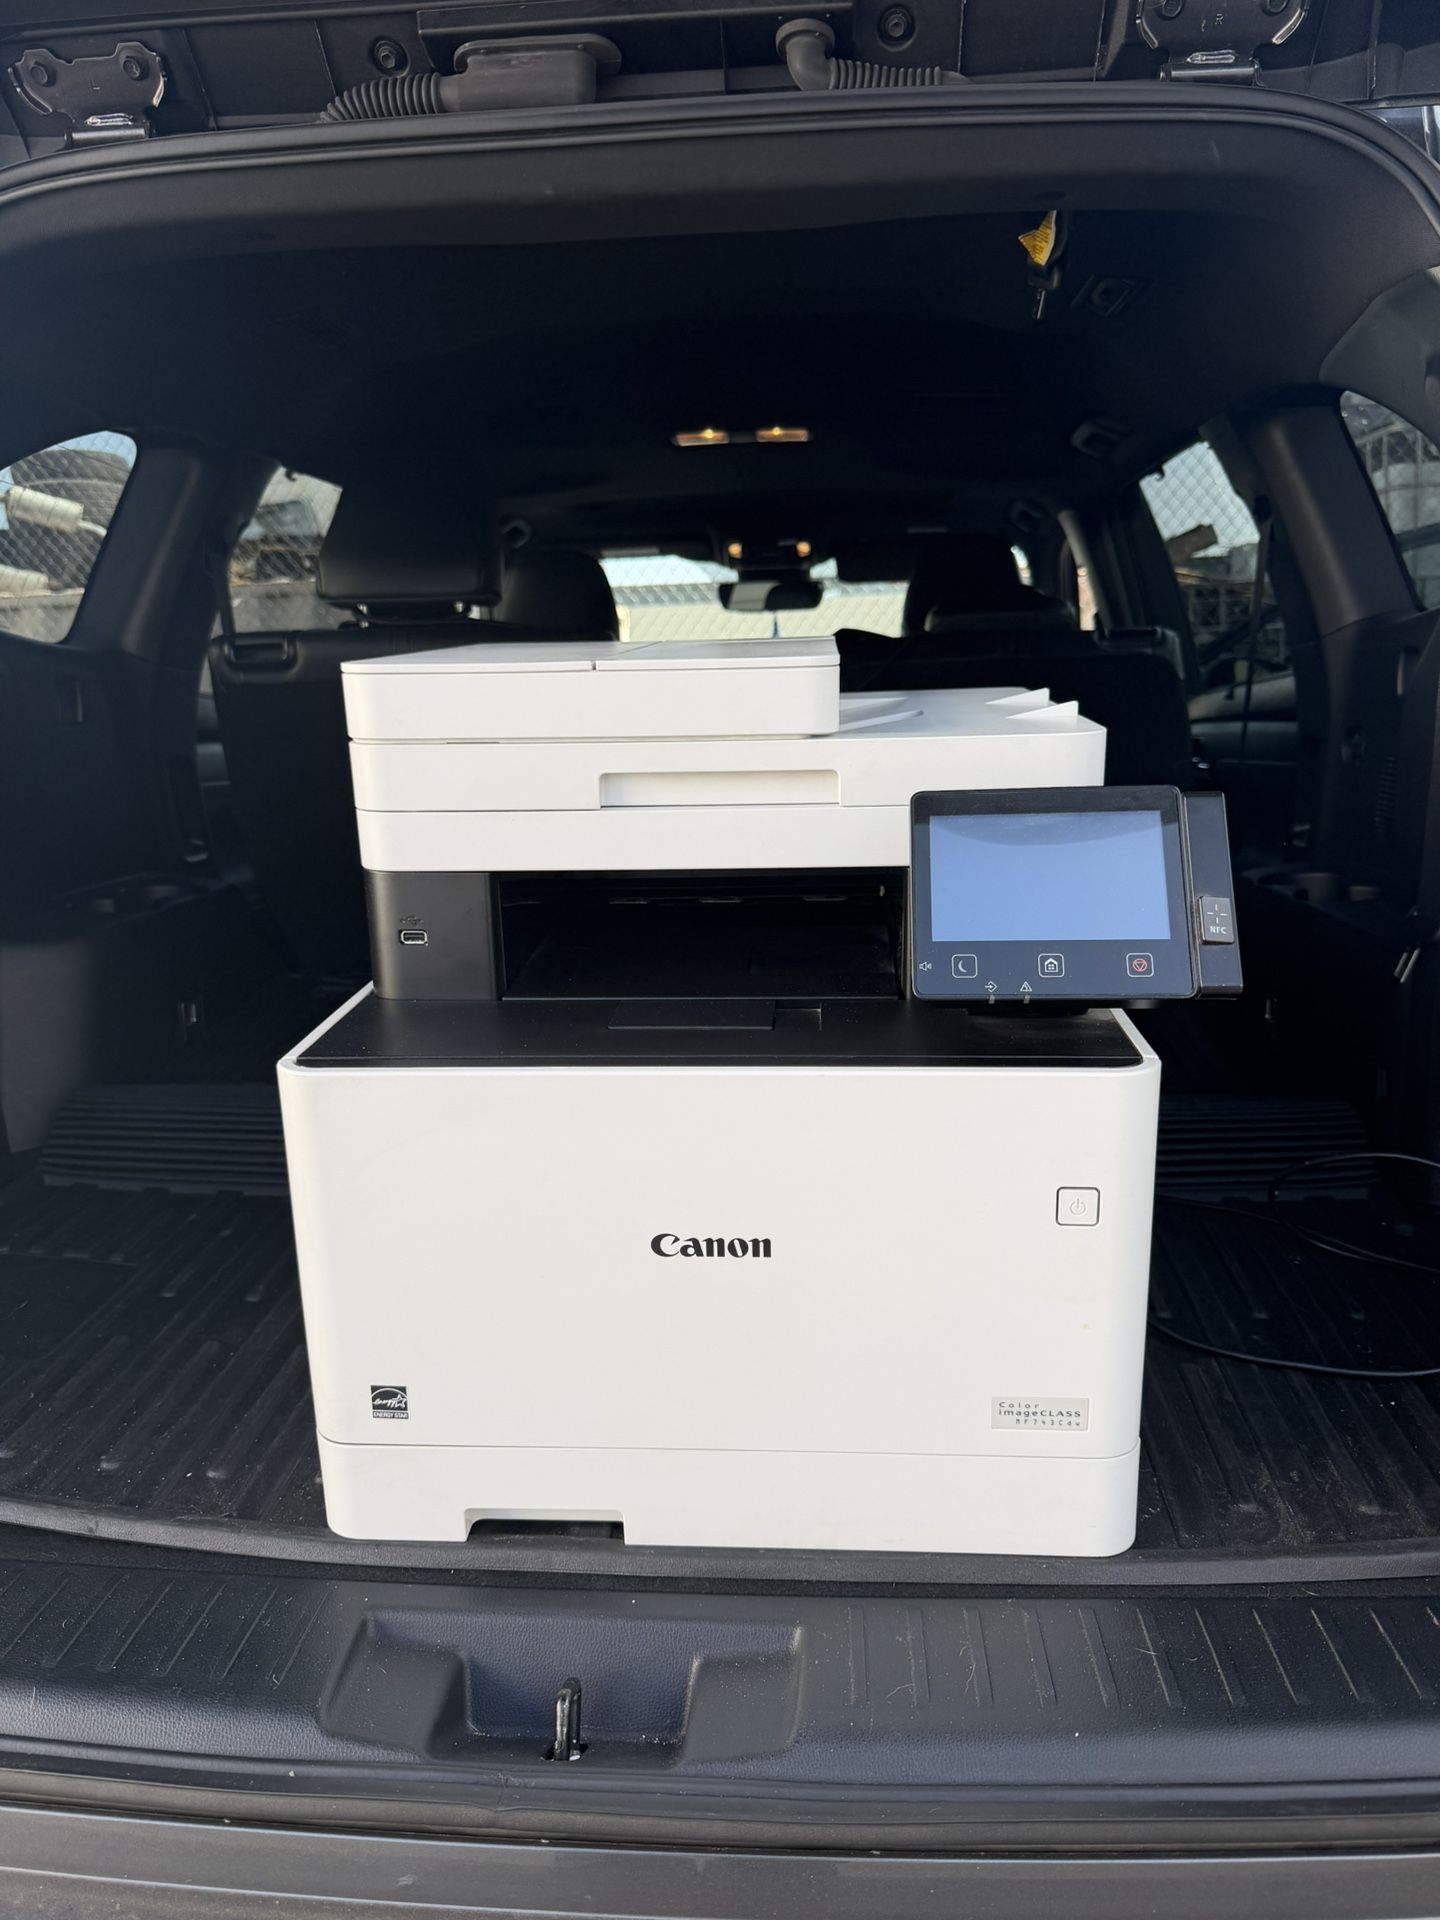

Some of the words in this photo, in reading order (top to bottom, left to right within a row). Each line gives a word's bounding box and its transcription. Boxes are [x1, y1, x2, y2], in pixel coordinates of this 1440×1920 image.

[1209, 925, 1228, 935] NFC
[650, 1233, 772, 1258] Canon
[998, 1401, 1040, 1409] Color
[998, 1408, 1081, 1418] imageCLASS
